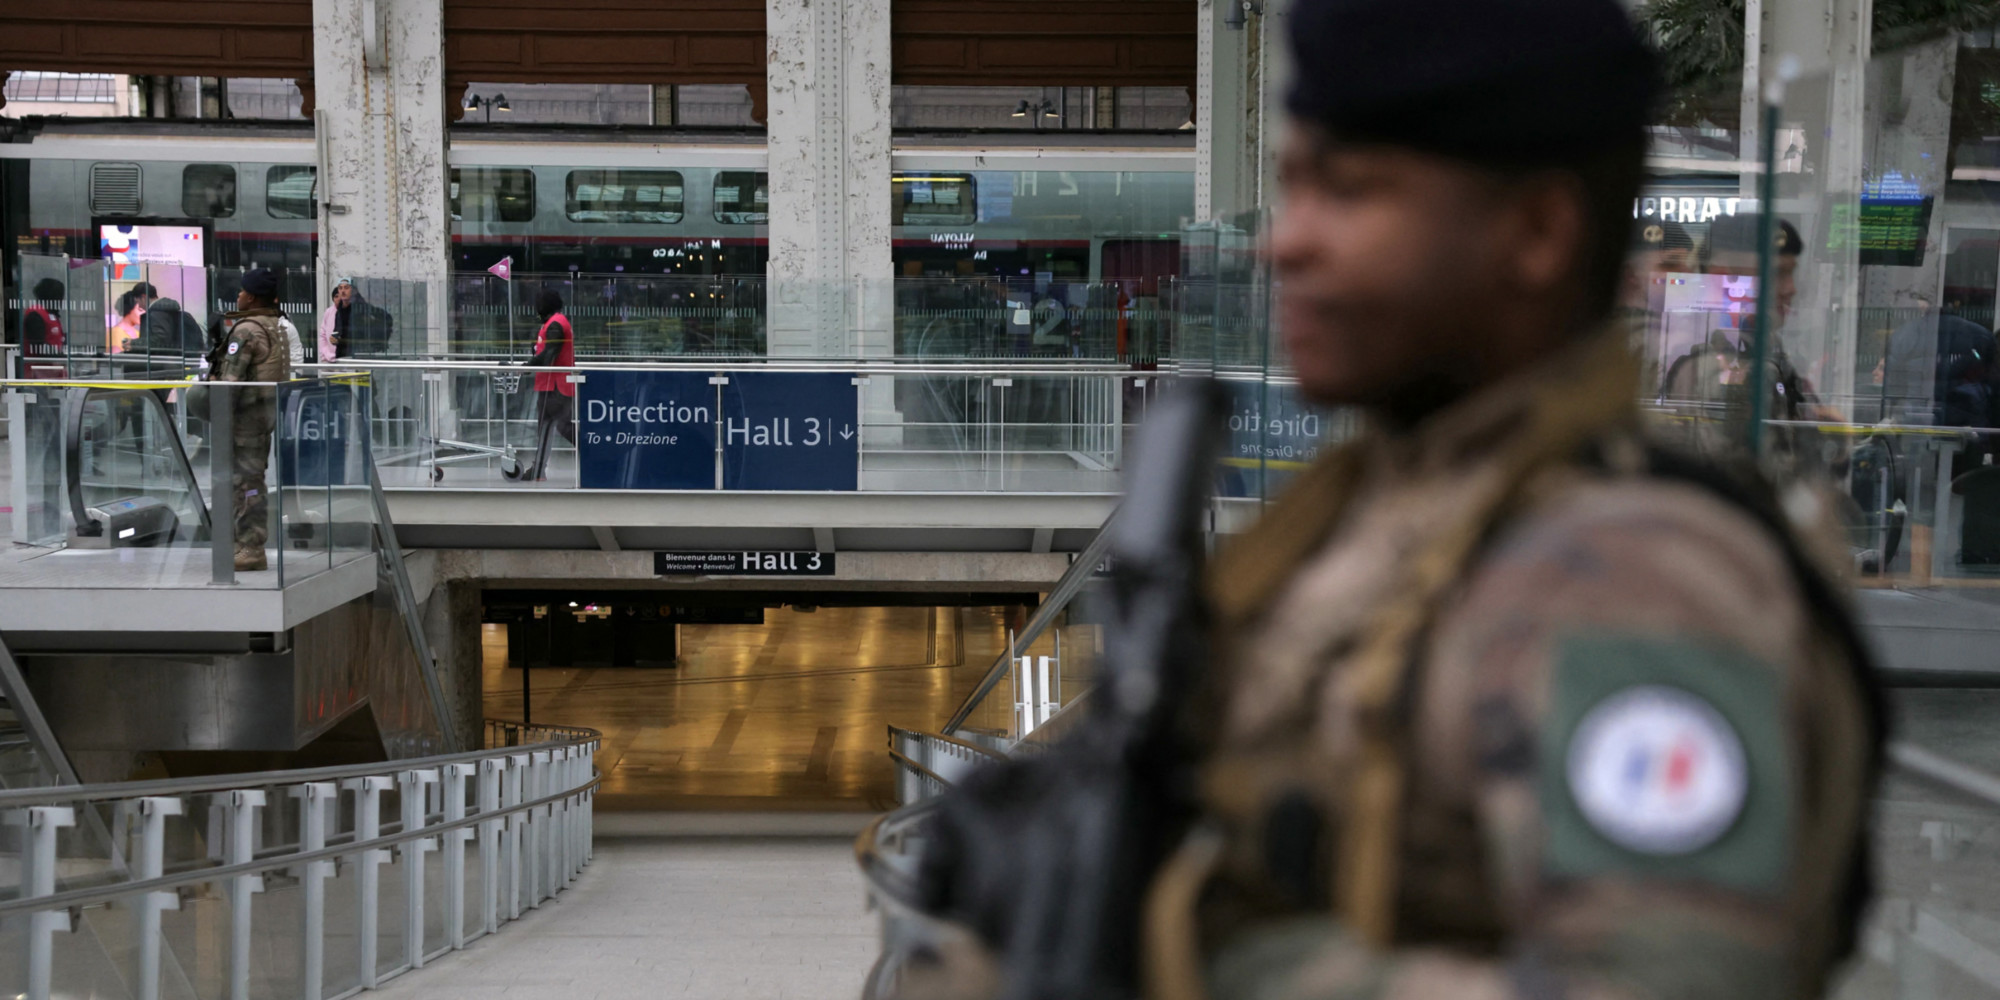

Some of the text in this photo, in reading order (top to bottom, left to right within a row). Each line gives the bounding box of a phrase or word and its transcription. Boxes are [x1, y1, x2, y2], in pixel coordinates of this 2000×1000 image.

[587, 399, 709, 424] Direction
[587, 432, 678, 445] To Direzione
[727, 417, 822, 446] Hall 3
[666, 553, 736, 561] Bienvenue dans le
[742, 551, 822, 571] Hall 3
[666, 563, 736, 571] Welcome Benvenuti
